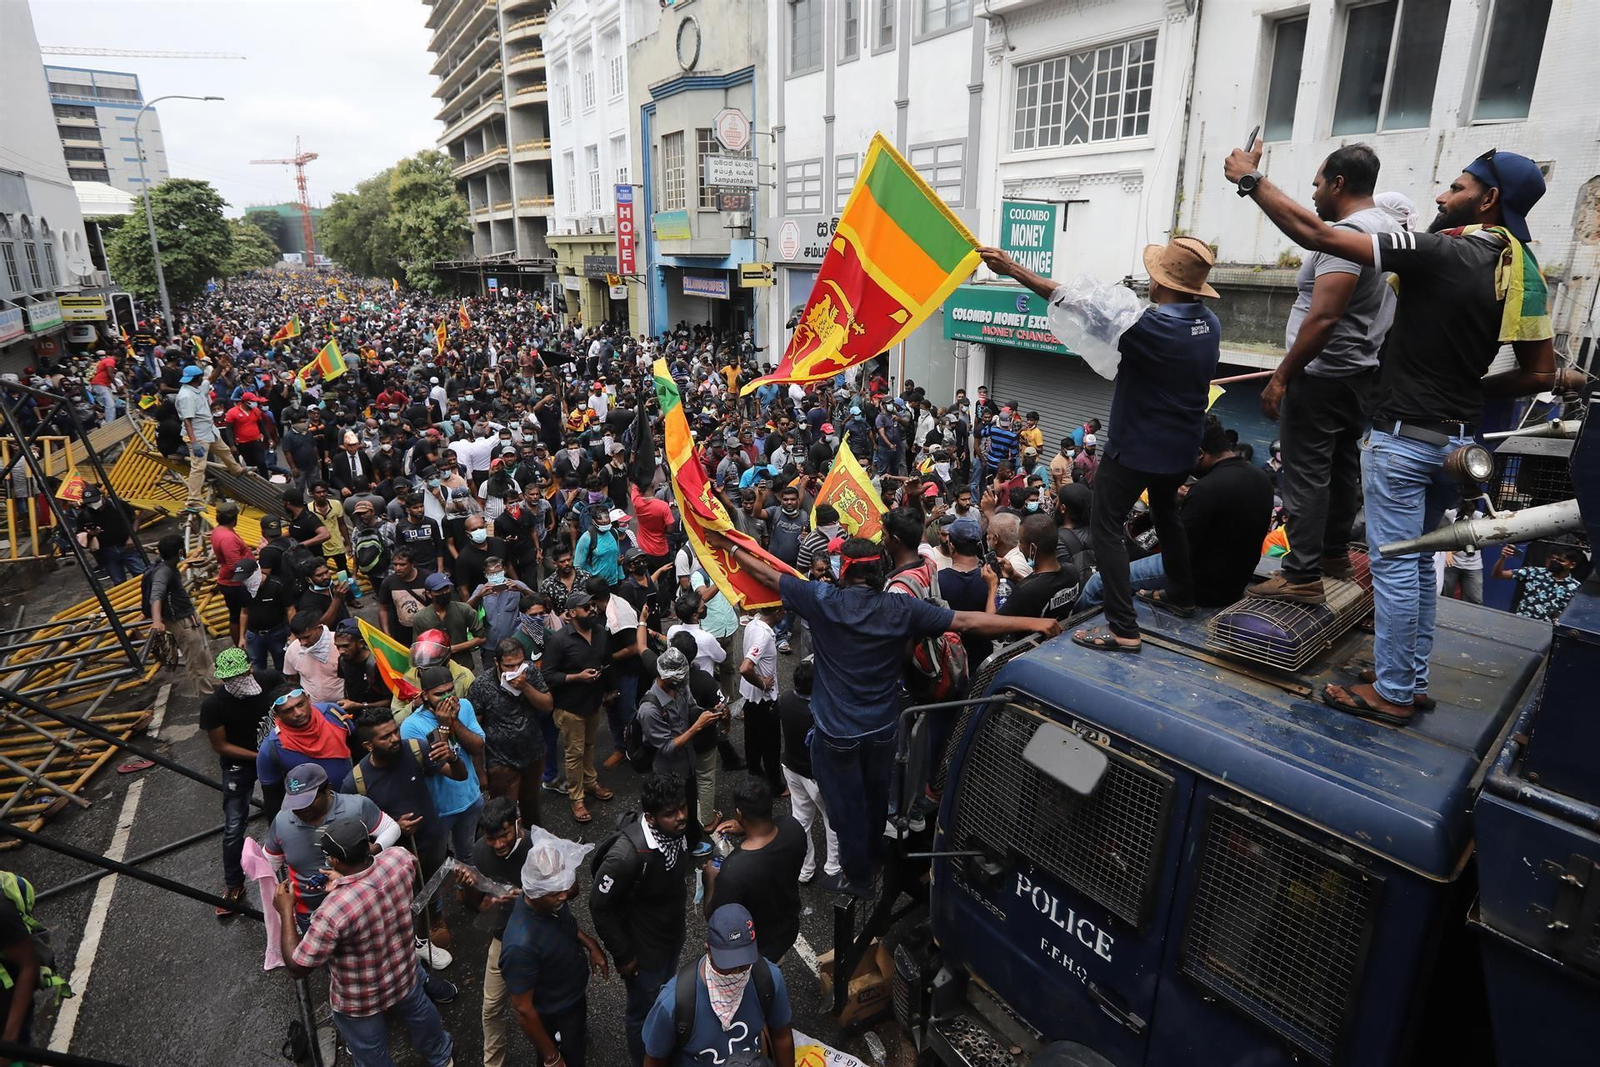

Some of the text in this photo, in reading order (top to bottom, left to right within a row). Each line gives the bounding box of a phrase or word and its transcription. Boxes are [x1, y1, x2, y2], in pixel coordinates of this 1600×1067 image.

[1009, 208, 1050, 221] COLOMBO
[619, 207, 633, 274] HOTEL
[1010, 223, 1046, 248] MONEY
[1004, 250, 1052, 274] XCHANGE
[952, 307, 993, 324] COLOMBO
[993, 311, 1026, 328] MONEY
[981, 325, 1064, 345] MONEY CHANGE
[598, 874, 614, 894] 3
[1015, 872, 1115, 963] POLICE
